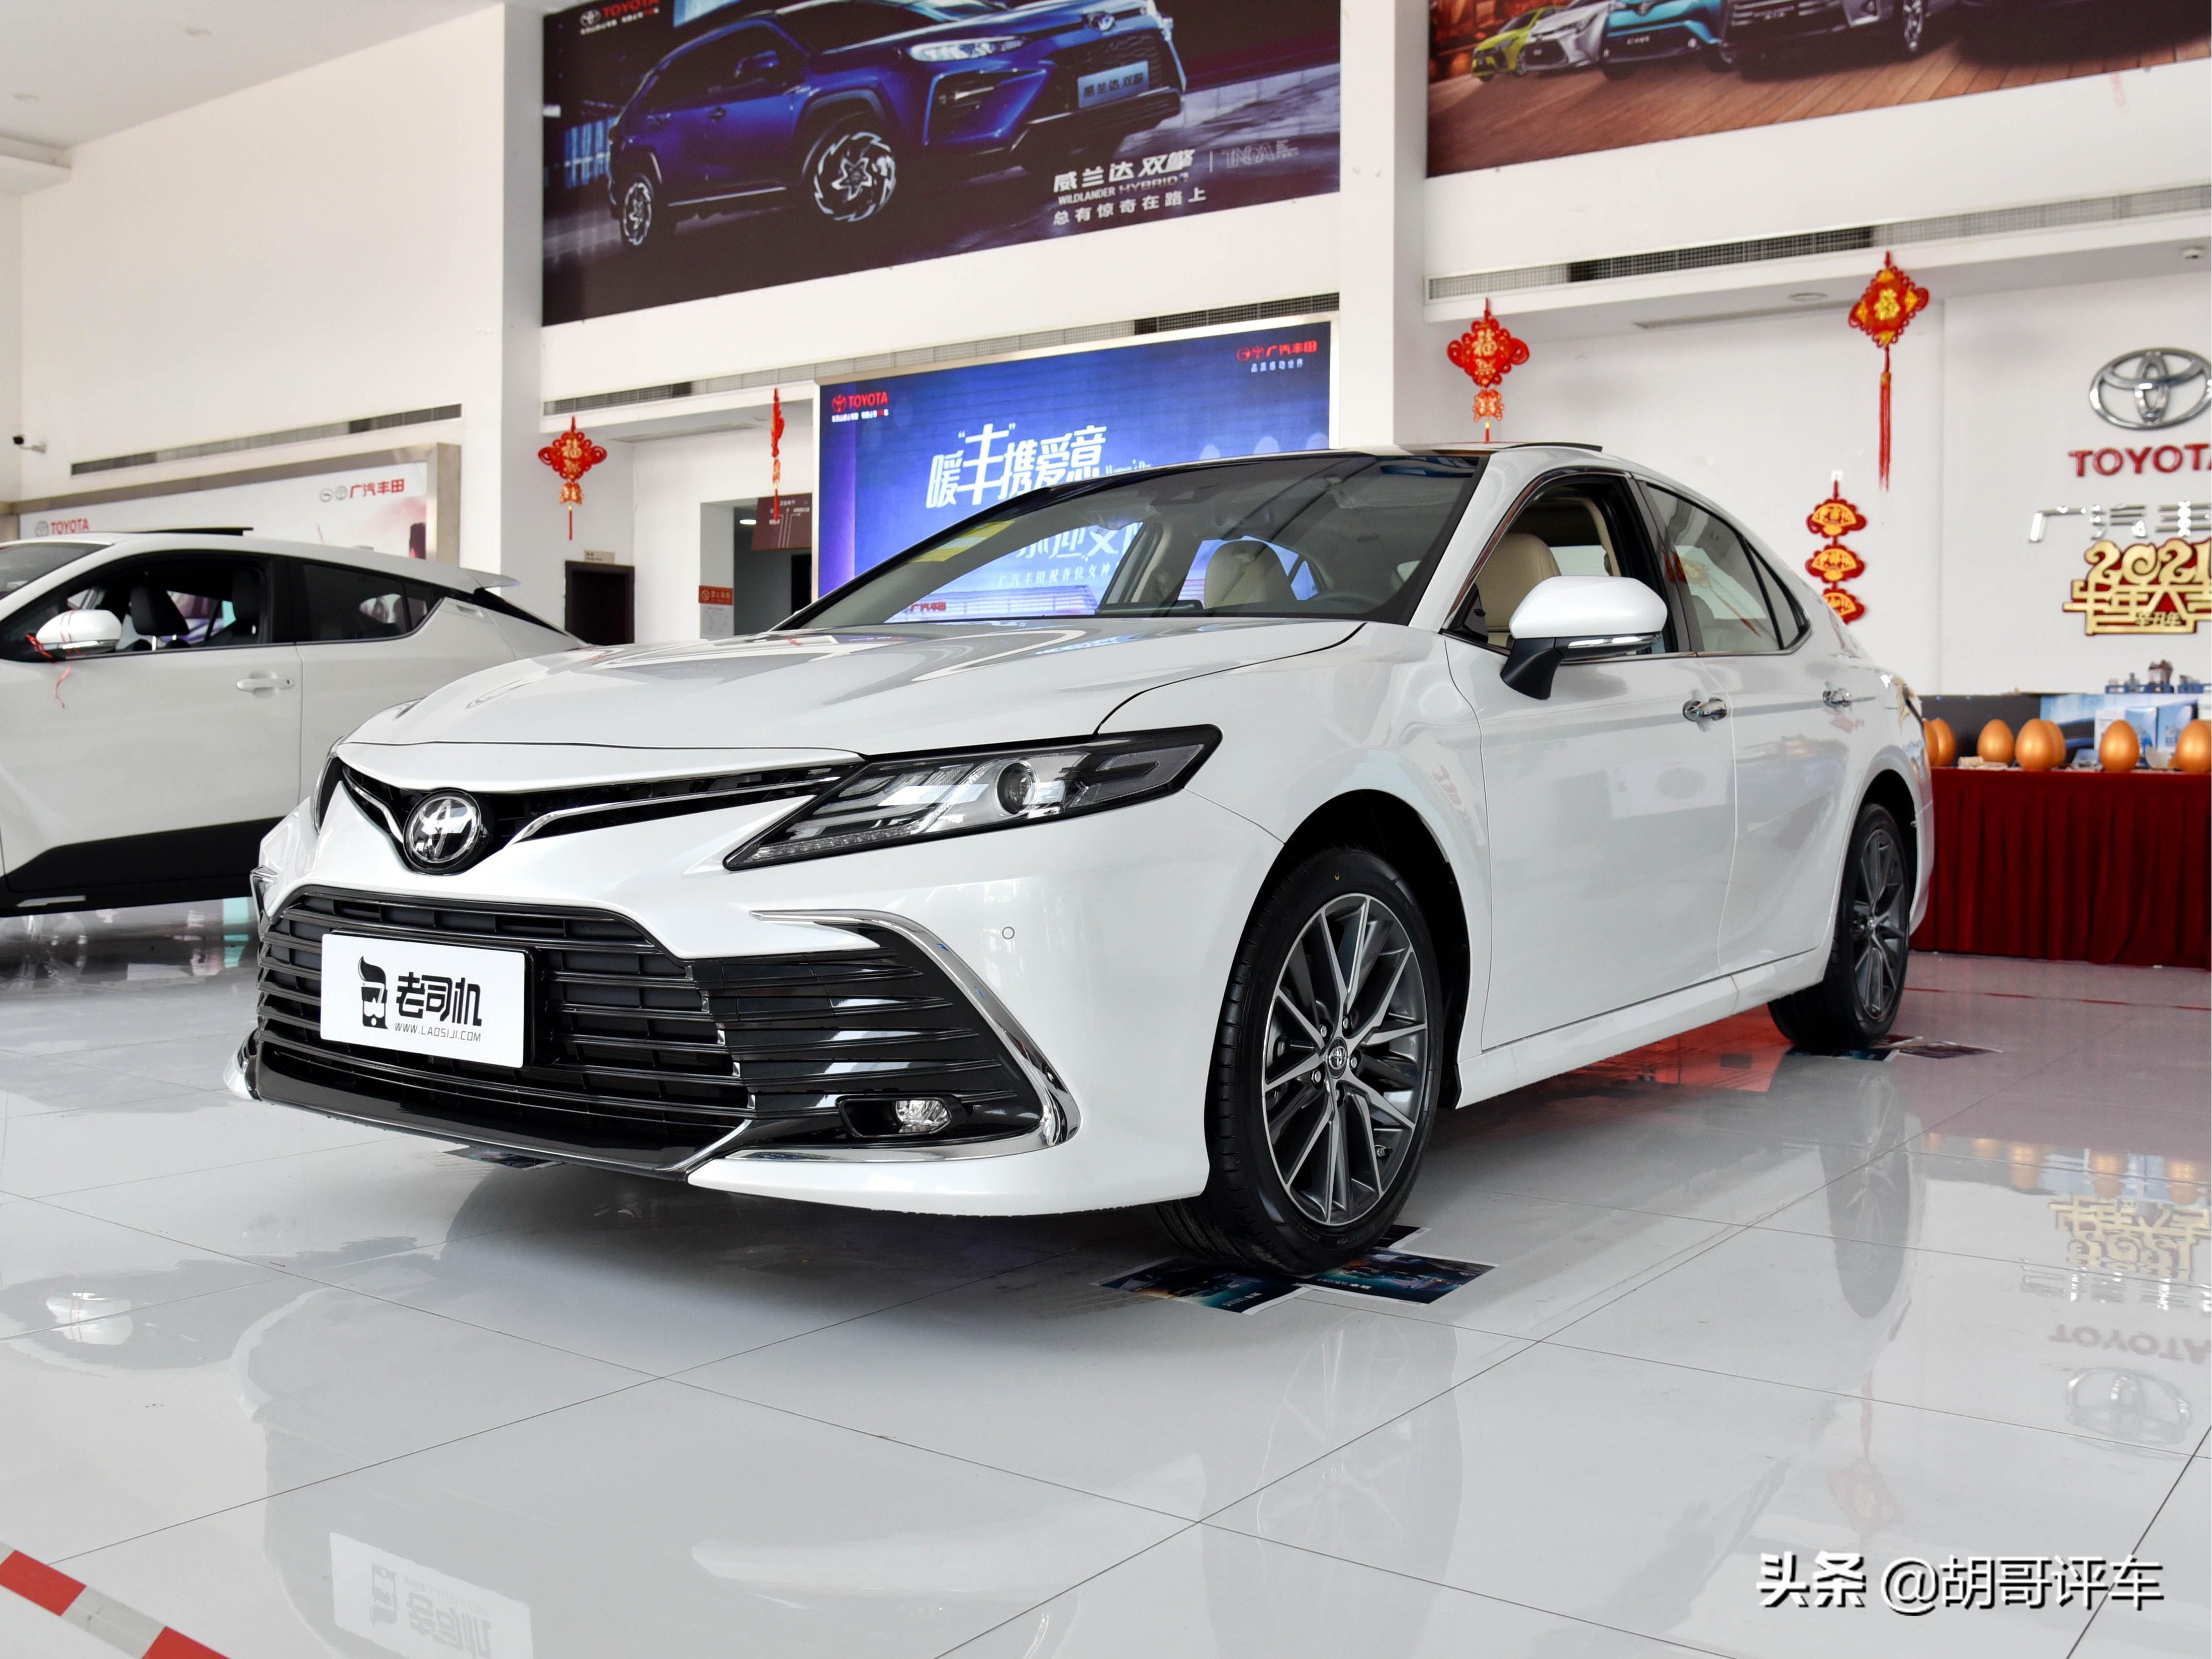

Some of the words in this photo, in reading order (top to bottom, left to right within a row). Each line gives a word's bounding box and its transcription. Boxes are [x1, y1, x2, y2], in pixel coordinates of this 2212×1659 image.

[1058, 186, 1116, 206] WILDLANDER
[1119, 175, 1178, 194] HYBRID
[1053, 187, 1207, 226] 总有惊奇在路上
[849, 391, 888, 409] TOYOTA
[2067, 442, 2212, 478] TOYOT
[349, 478, 405, 499] 广汽丰田
[51, 518, 89, 534] TOYOTA
[396, 972, 482, 1026] 老司机
[395, 1023, 481, 1042] WWW.LAOSIJI.COM
